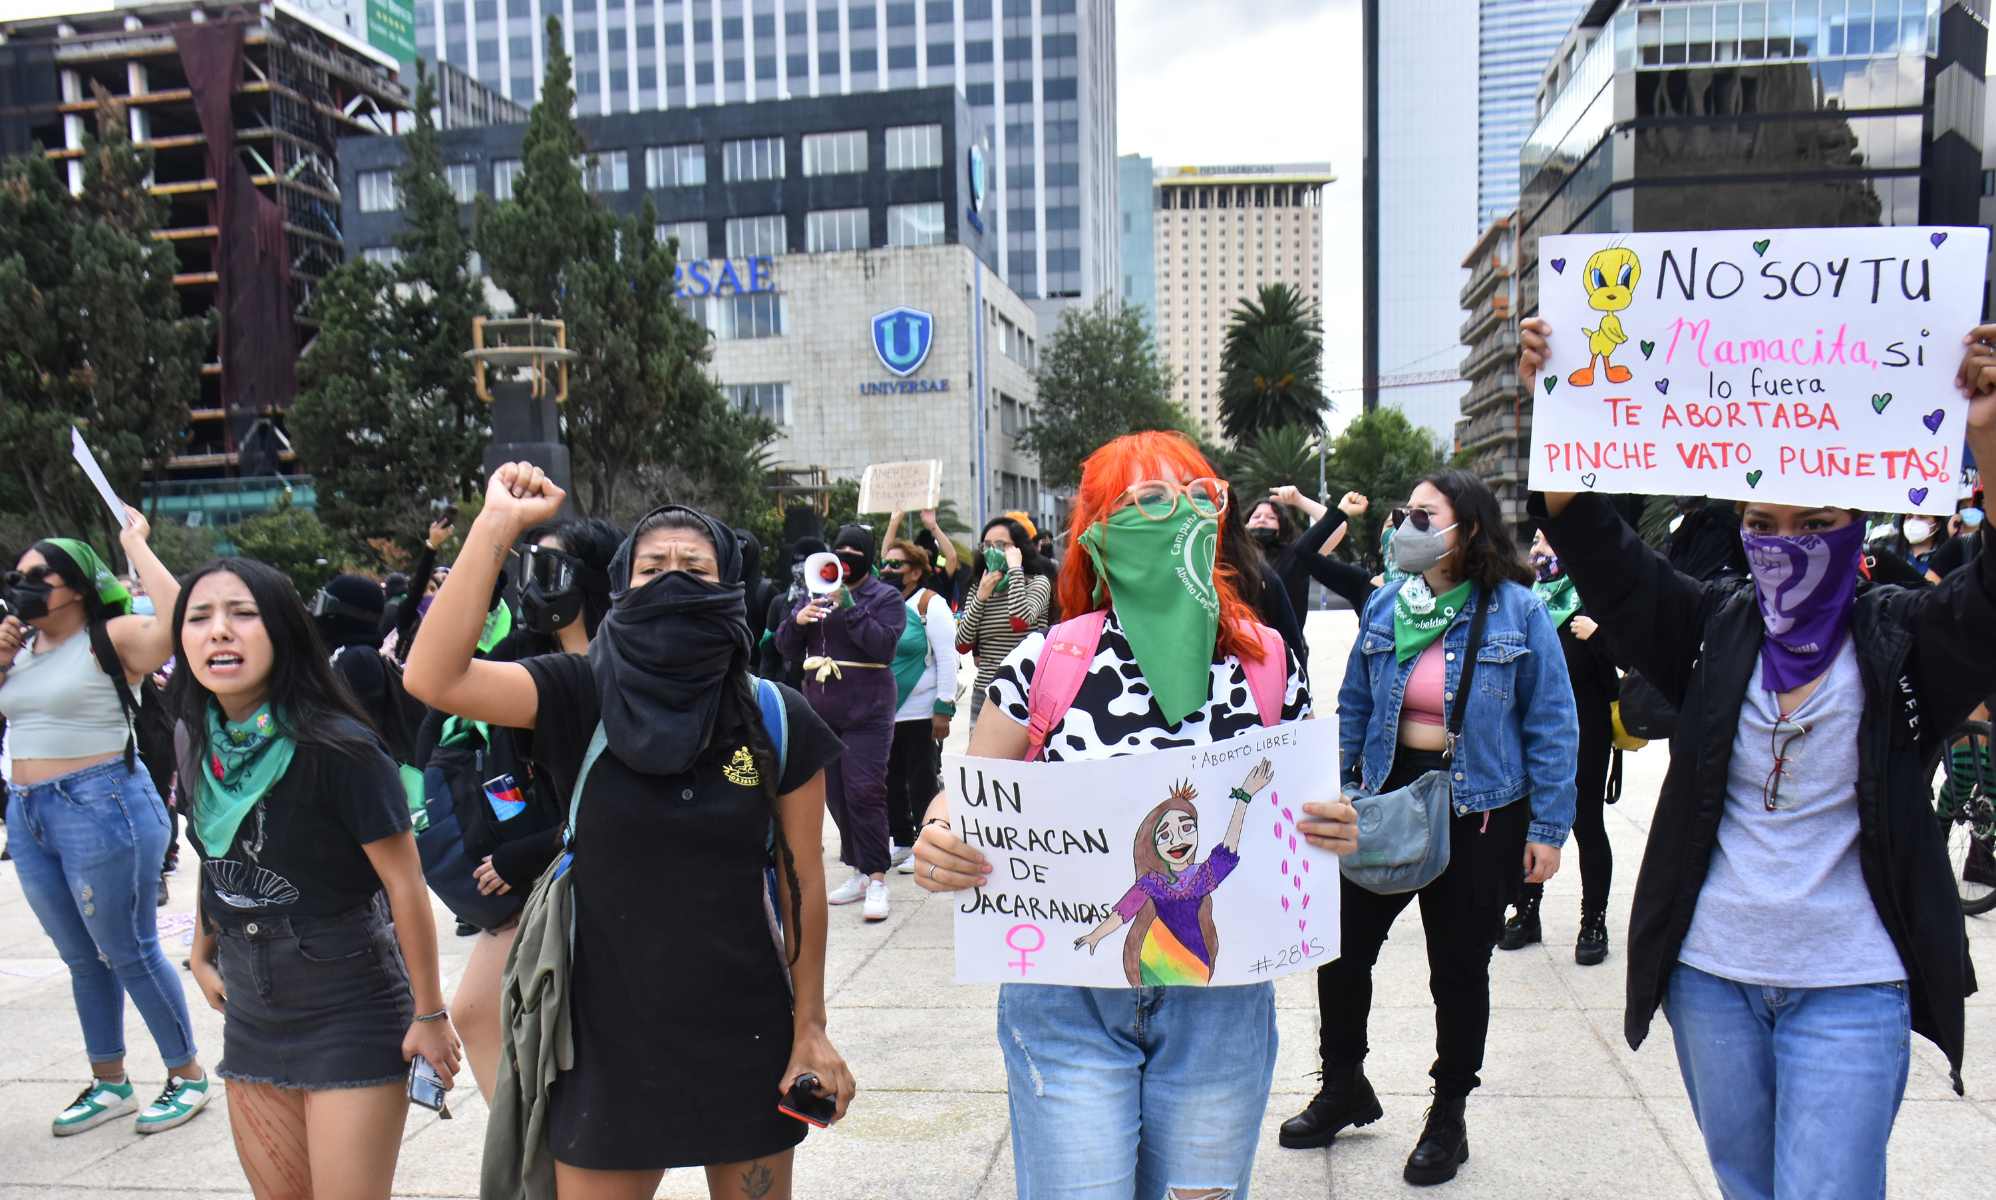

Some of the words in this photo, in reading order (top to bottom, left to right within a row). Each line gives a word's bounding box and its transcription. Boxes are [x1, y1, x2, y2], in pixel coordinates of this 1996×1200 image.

[1657, 248, 1743, 300] NO
[1760, 257, 1848, 299] SOY
[1862, 258, 1930, 303] TU
[1666, 316, 1878, 369] Mamacita,
[1883, 330, 1929, 367] si
[859, 379, 950, 396] UNIVERSAE
[1710, 372, 1731, 398] lo
[1752, 368, 1824, 396] fuera
[1604, 397, 1643, 427] TE
[1662, 401, 1840, 431] ABORTABA
[1545, 441, 1656, 471] PINCHE
[1676, 442, 1752, 470] VATO
[1780, 446, 1950, 483] PUÑETAS!
[1175, 566, 1197, 594] Aborto
[1192, 744, 1252, 768] ¡ABORTO
[1256, 729, 1297, 752] LIBRE!
[960, 767, 1021, 813] UN
[961, 816, 1109, 855] HURACAN
[1010, 858, 1048, 883] DE
[960, 886, 1111, 924] JACARANDAS
